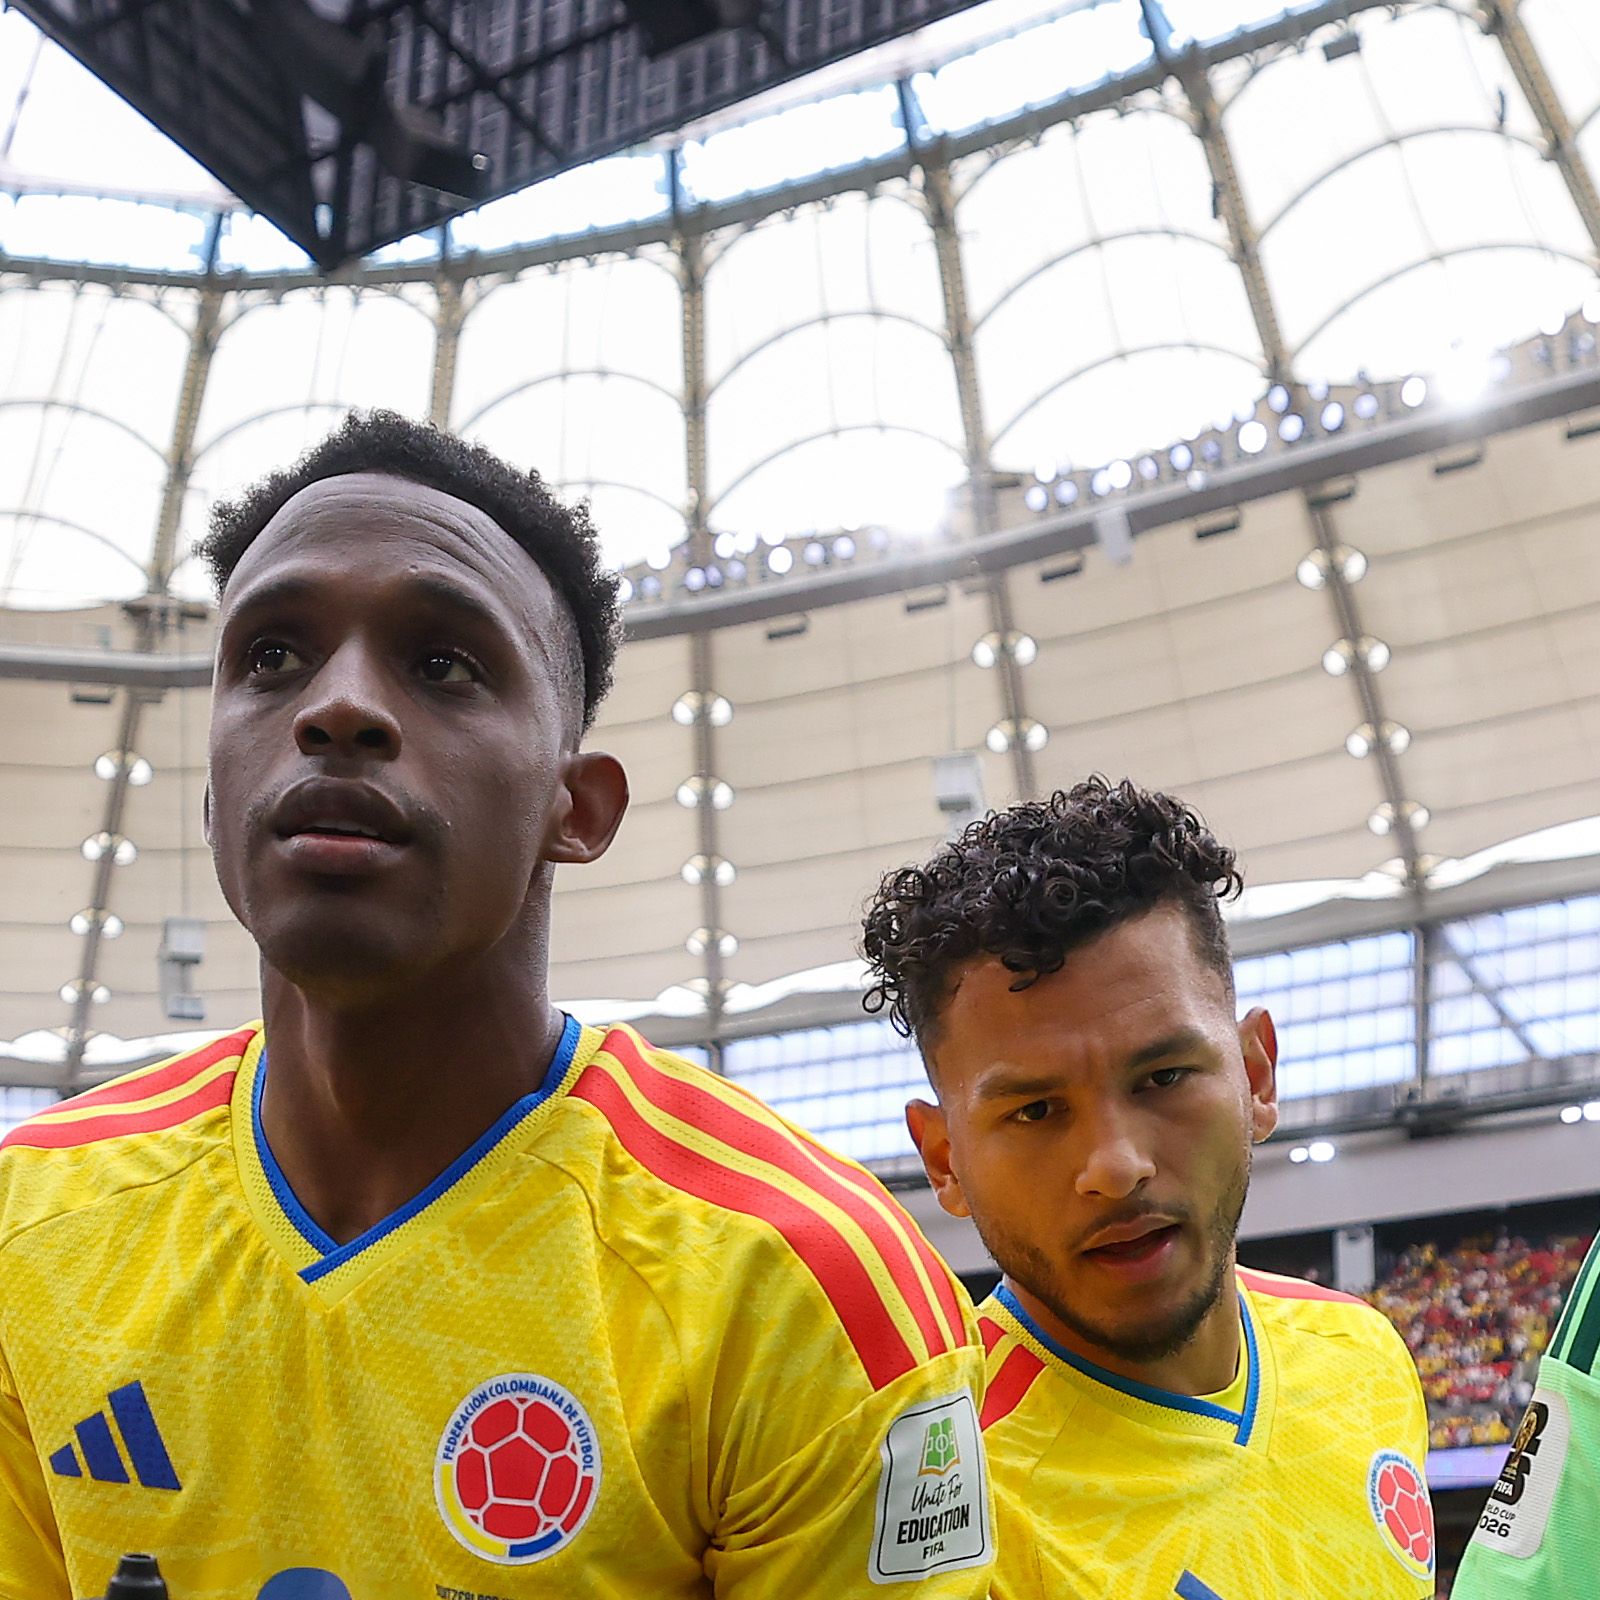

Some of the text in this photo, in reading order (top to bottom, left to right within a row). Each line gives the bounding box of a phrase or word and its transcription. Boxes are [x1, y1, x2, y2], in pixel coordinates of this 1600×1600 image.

[442, 1379, 595, 1472] FEDERACIÓN COLOMBIANA DE FÚTBOL
[911, 1473, 963, 1514] Unite For
[1494, 1480, 1514, 1496] FIFA
[896, 1504, 970, 1545] EDUCATION
[1479, 1515, 1511, 1538] 026
[1499, 1509, 1516, 1521] CUP
[922, 1541, 945, 1560] FIFA
